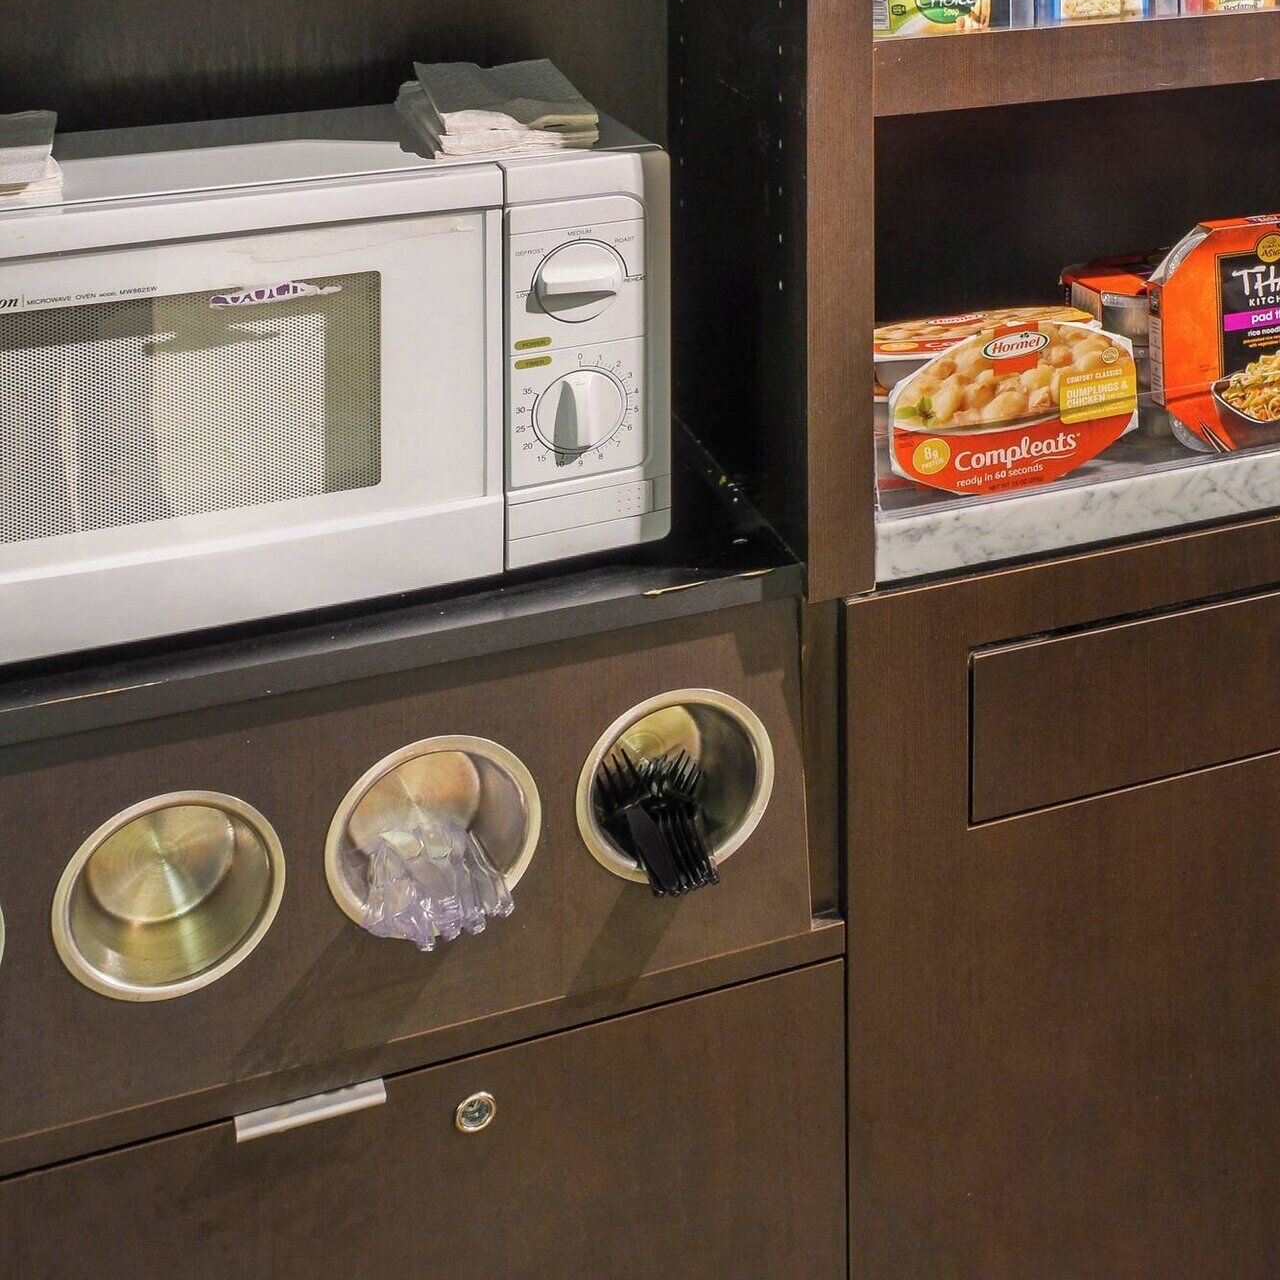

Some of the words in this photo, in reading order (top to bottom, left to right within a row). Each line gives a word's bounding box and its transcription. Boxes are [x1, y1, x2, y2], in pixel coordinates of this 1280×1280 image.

[567, 228, 593, 237] MEDIUM
[614, 235, 636, 244] ROAST
[515, 247, 545, 258] DEFROST
[26, 296, 73, 306] MICROWAVE
[75, 293, 98, 302] OVEN
[1251, 310, 1273, 325] pad
[1247, 328, 1261, 338] rice
[521, 339, 547, 349] POWER
[989, 335, 1042, 356] Hormel
[577, 352, 584, 360] 0
[525, 359, 545, 367] TIMER
[615, 360, 622, 368] 2
[627, 371, 634, 379] 3
[1065, 374, 1094, 384] COMFORT
[522, 388, 533, 396] 35
[1065, 393, 1107, 409] CHICKEN
[515, 406, 526, 414] 30
[515, 425, 526, 434] 25
[627, 424, 633, 432] 6
[522, 442, 533, 451] 20
[923, 446, 939, 461] 8g
[954, 433, 1077, 472] Compleats
[536, 454, 547, 463] 15
[955, 474, 983, 488] ready
[984, 472, 994, 483] in
[995, 470, 1007, 480] 60
[1007, 462, 1044, 477] seconds
